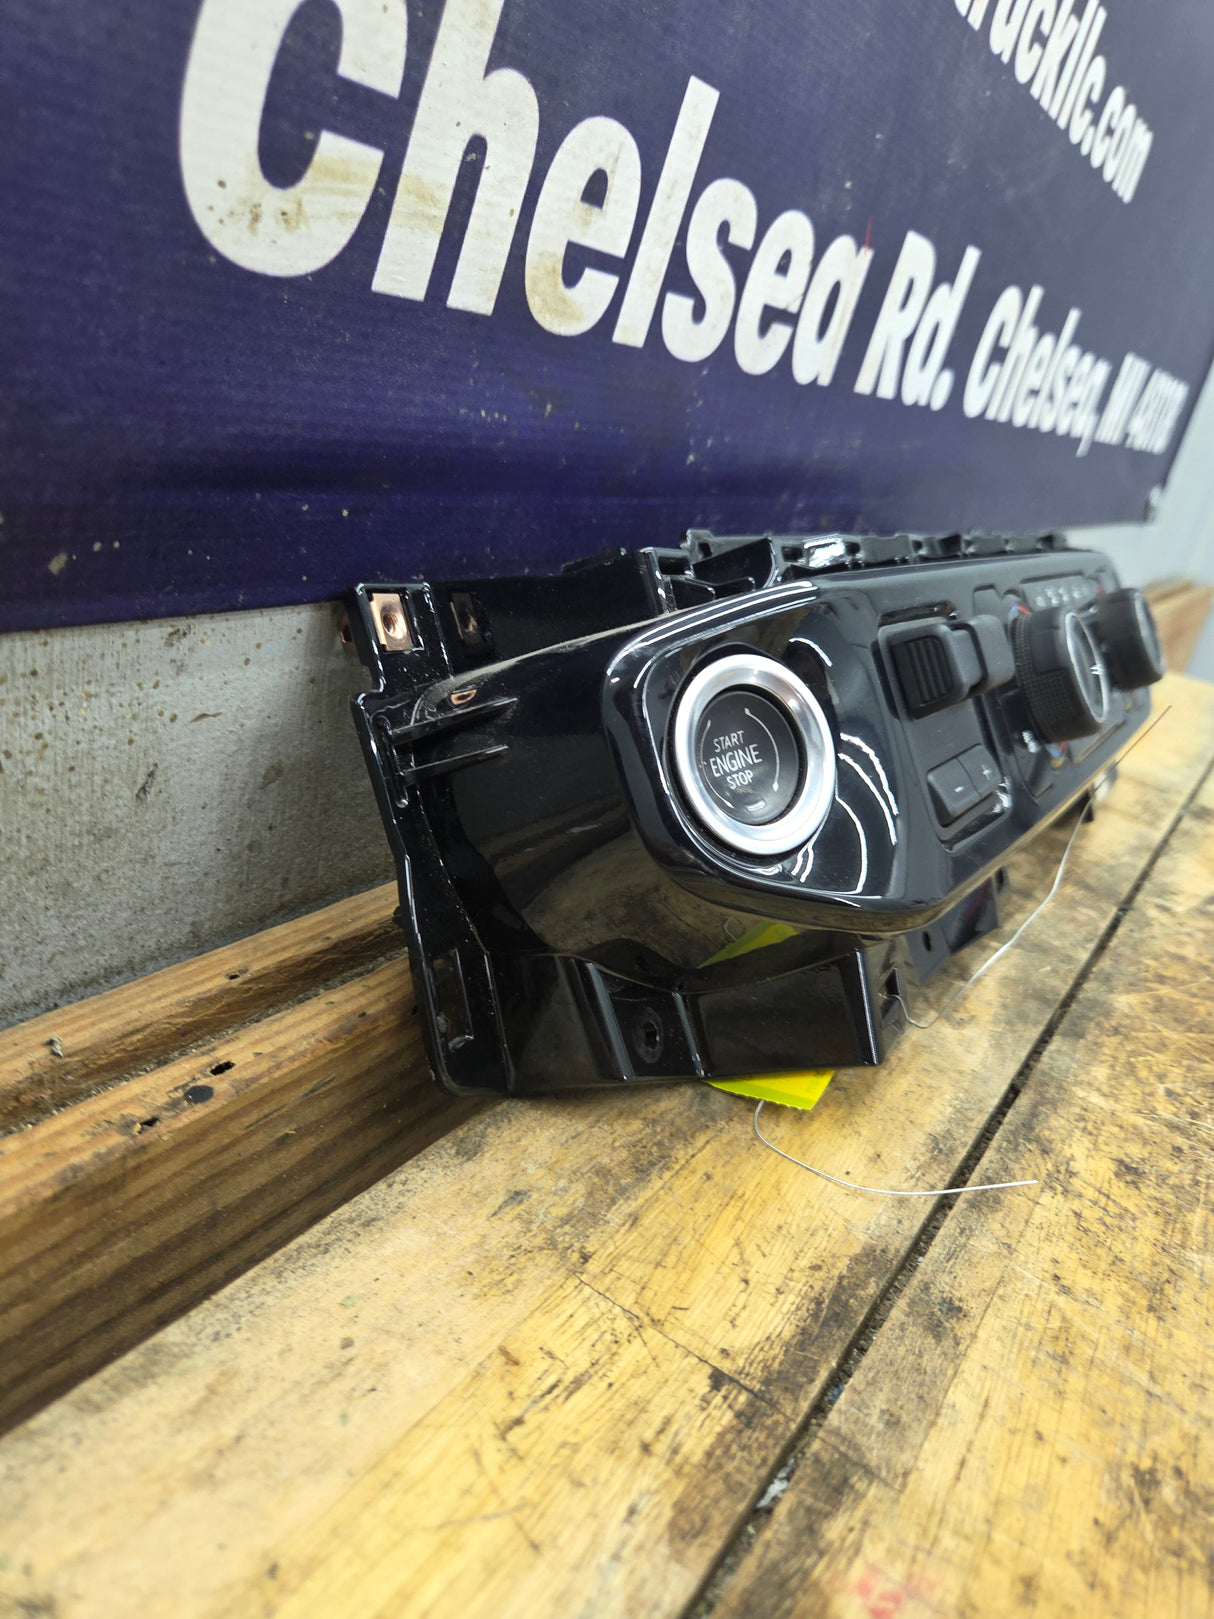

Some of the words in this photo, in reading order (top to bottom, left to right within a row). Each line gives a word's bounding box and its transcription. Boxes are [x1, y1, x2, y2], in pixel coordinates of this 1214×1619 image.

[955, 0, 1153, 204] uckllc.com
[179, 0, 874, 387] Chelsea
[854, 230, 982, 411] Rd.
[963, 284, 1112, 457] Chelsea,
[713, 730, 745, 753] START
[709, 744, 763, 777] ENGINE
[726, 770, 754, 790] STOP
